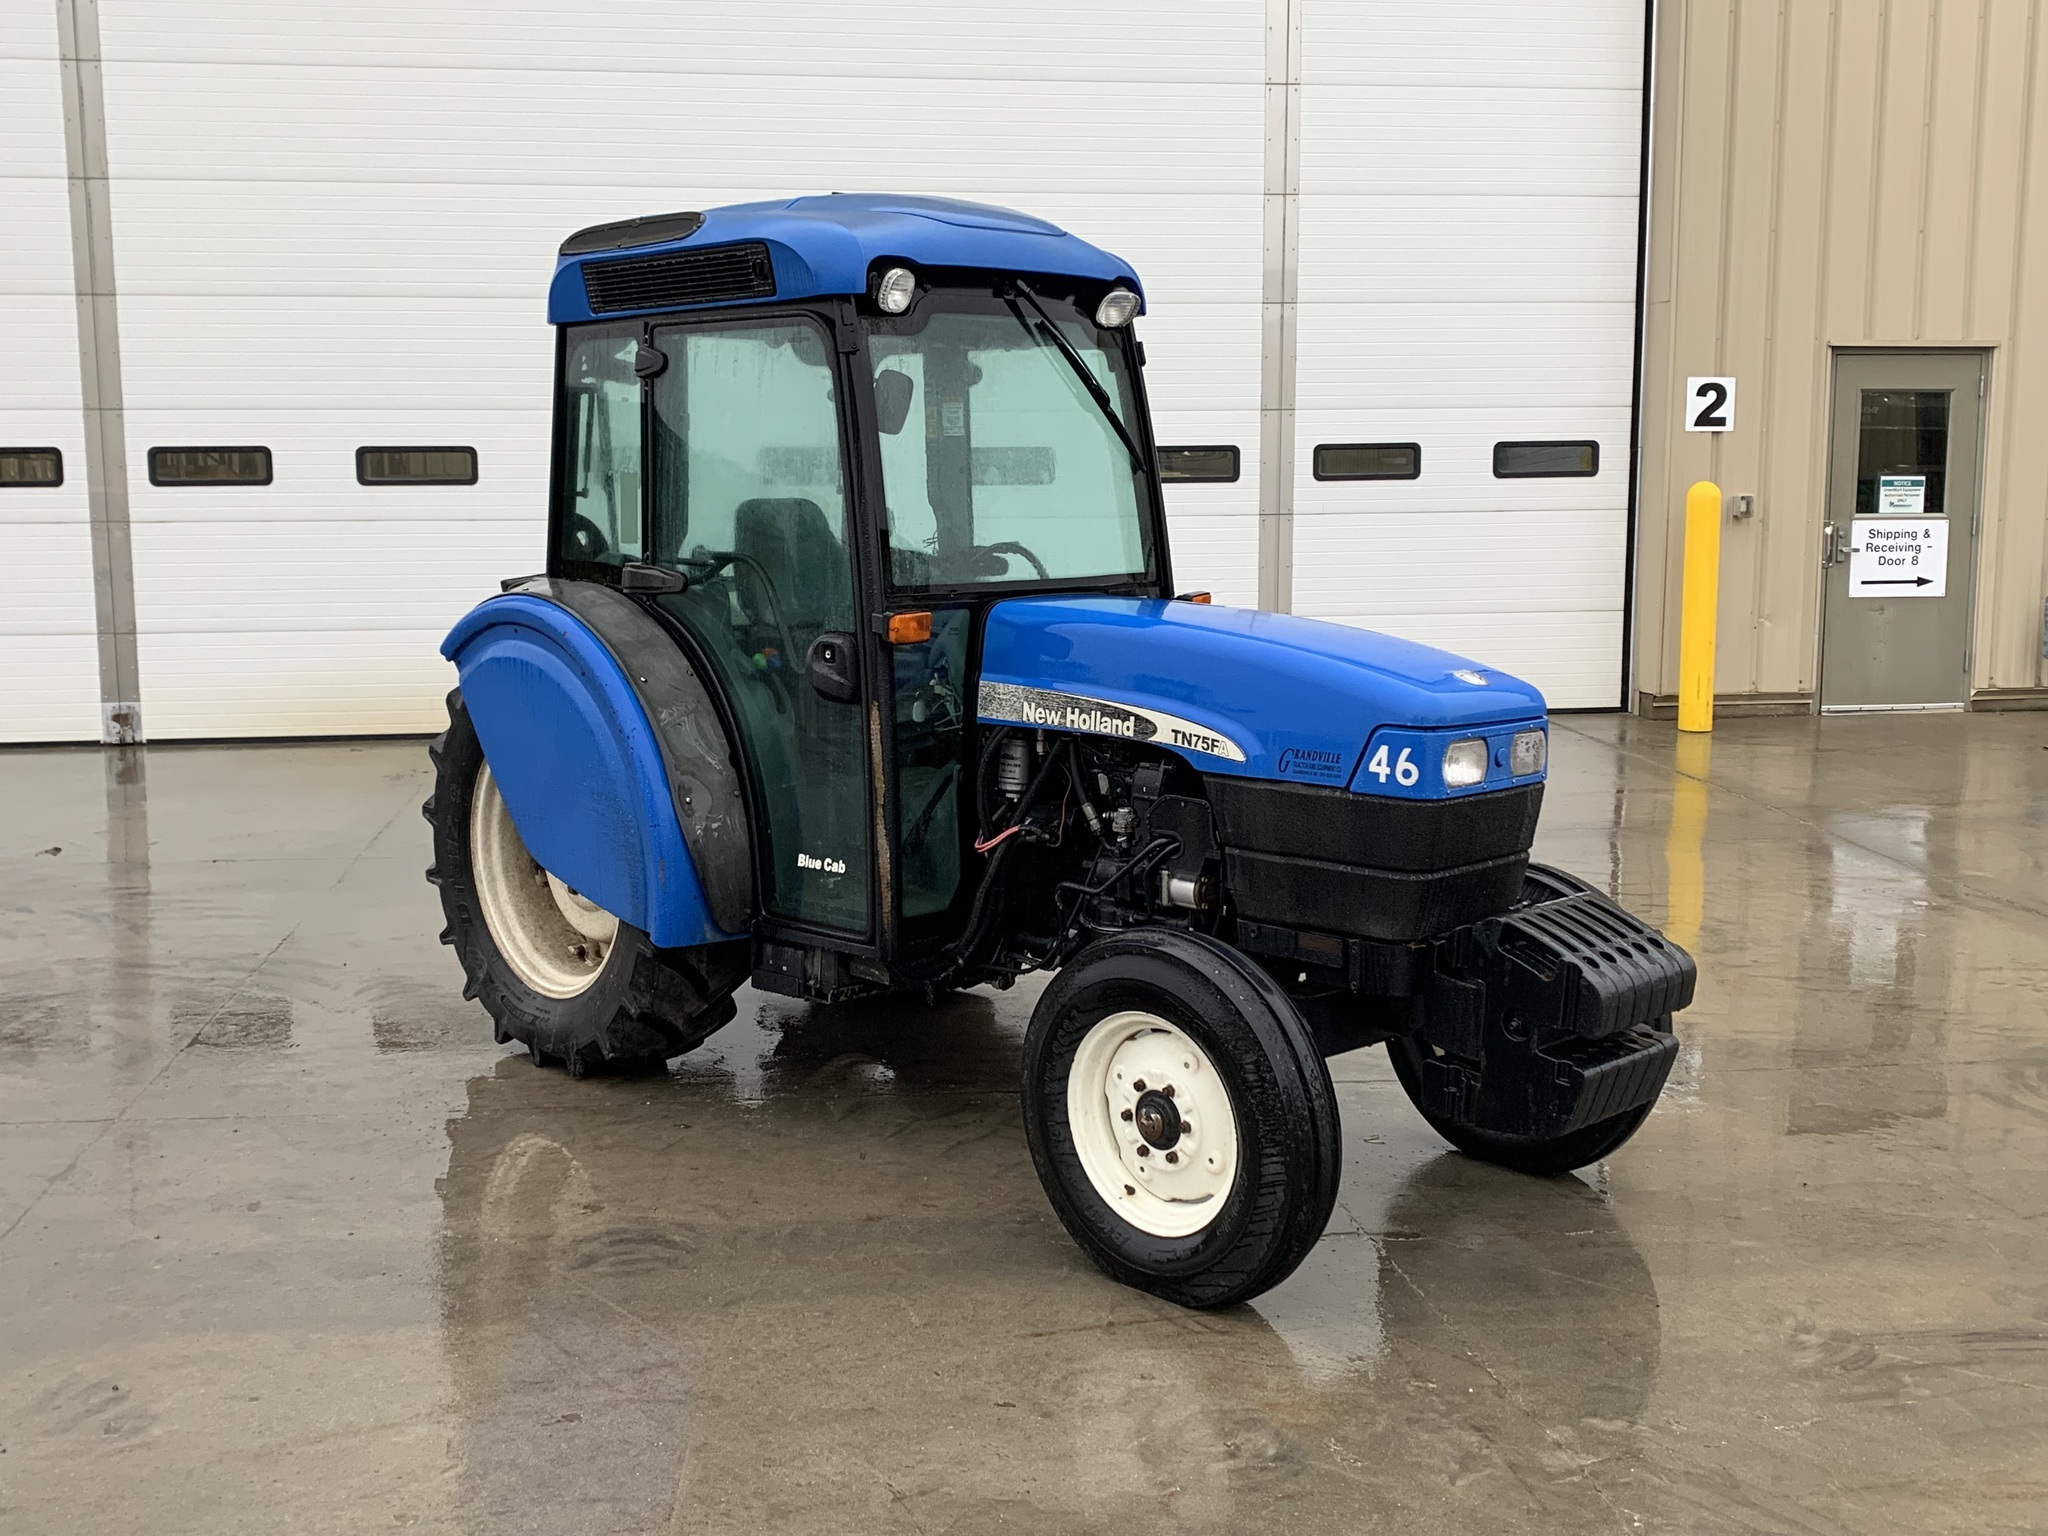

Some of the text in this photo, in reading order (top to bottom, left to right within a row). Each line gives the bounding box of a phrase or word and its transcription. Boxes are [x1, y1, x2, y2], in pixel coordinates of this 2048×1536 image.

[1693, 382, 1728, 427] 2
[1868, 528, 1931, 541] Shipping &
[1866, 542, 1922, 555] Receiving
[1878, 555, 1919, 566] Door 8
[1022, 701, 1136, 738] New Holland
[1171, 728, 1230, 757] TN75FA
[1278, 747, 1342, 773] GRANDVILLE
[1368, 744, 1420, 787] 46
[797, 853, 847, 874] Blue Cab
